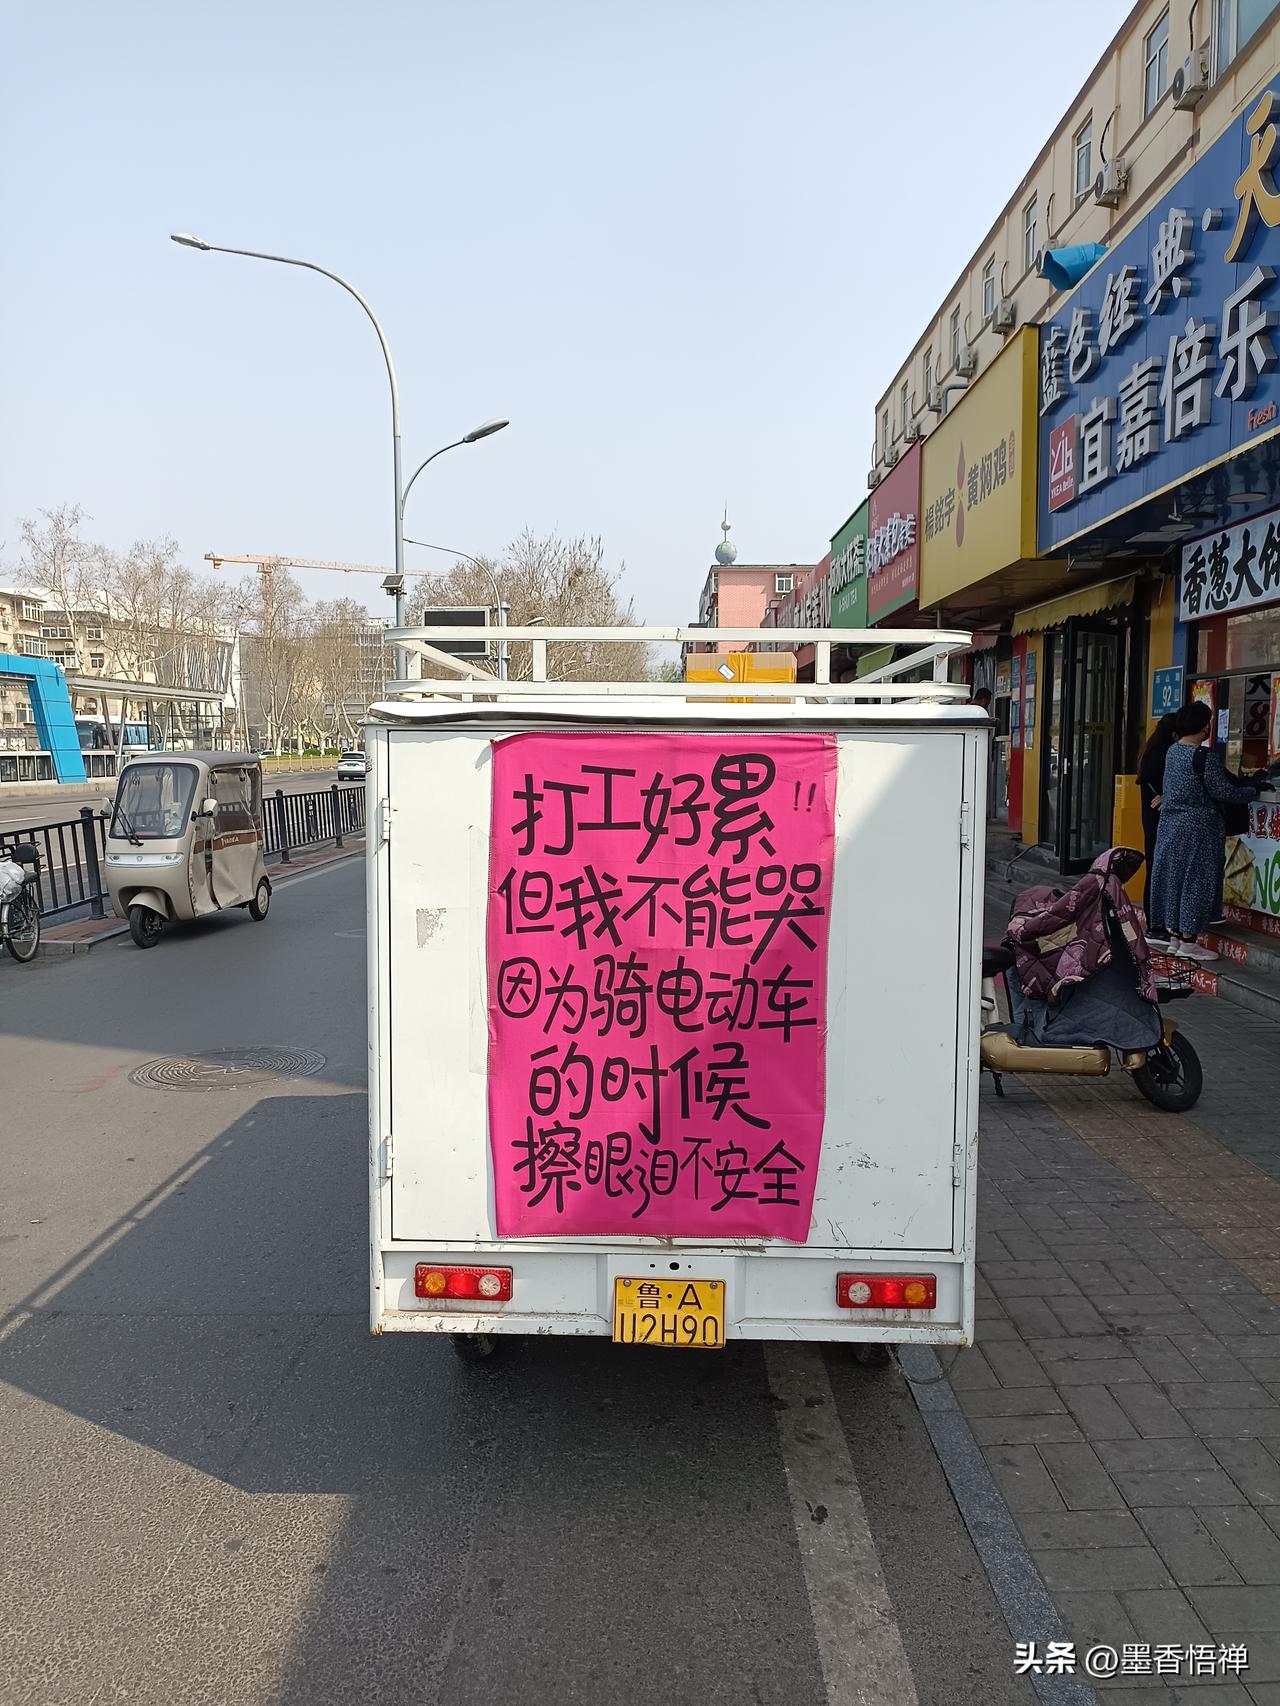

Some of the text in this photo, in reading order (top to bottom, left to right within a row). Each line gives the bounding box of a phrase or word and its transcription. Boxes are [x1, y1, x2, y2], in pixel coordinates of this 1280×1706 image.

[1078, 266, 1280, 495] 宜嘉倍乐
[1247, 400, 1278, 432] Fresh
[967, 438, 1007, 512] 黄焖鸡
[497, 862, 825, 965] 但我不能哭
[497, 949, 818, 1043] 因为骑电动车
[528, 1041, 772, 1145] 的时候
[511, 1115, 807, 1219] 擦眼泪不安全
